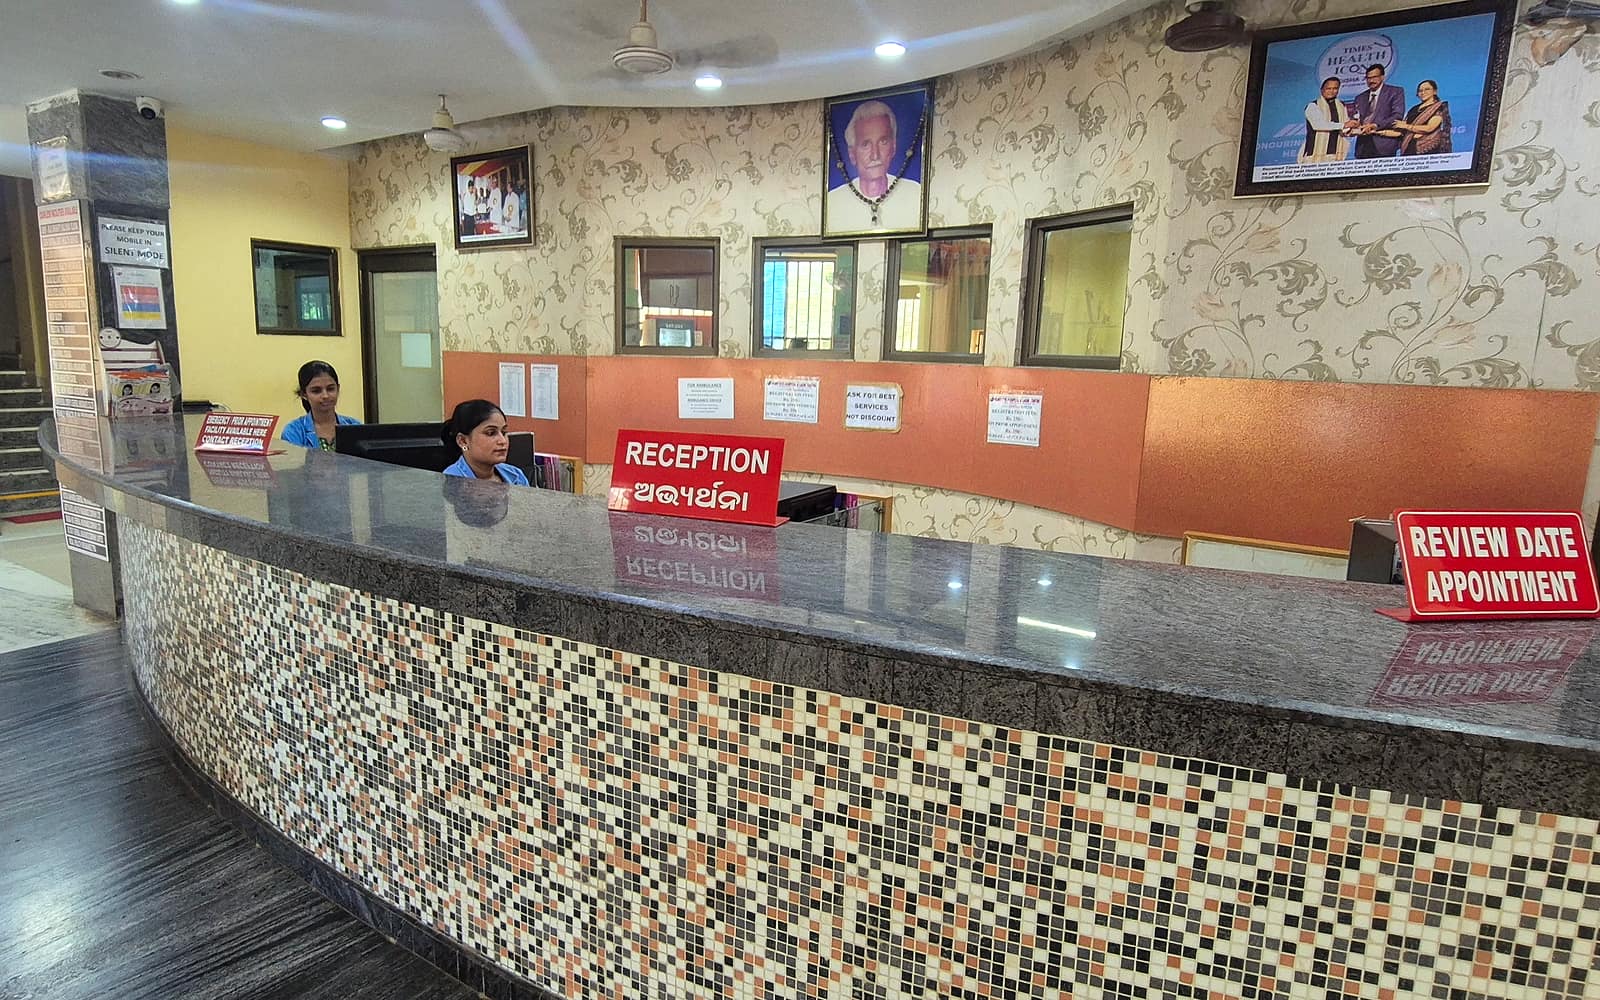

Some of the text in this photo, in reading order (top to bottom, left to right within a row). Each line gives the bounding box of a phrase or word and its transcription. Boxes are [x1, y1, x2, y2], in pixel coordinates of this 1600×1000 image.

[1344, 45, 1373, 54] TIMES
[1328, 50, 1386, 65] HEALTH
[102, 224, 126, 233] PLEASE
[117, 236, 143, 245] MOBILE
[105, 247, 165, 260] SILENT MODE
[855, 403, 889, 411] SERVICES
[860, 414, 896, 422] DISCOUNT
[205, 426, 268, 437] FACILITY AVAILABLE HERE
[202, 435, 264, 446] CONTACT RECEPTION
[625, 440, 770, 475] RECEPTION
[1409, 526, 1579, 559] REVIEW DATE
[1426, 570, 1579, 603] APPOINTMENT
